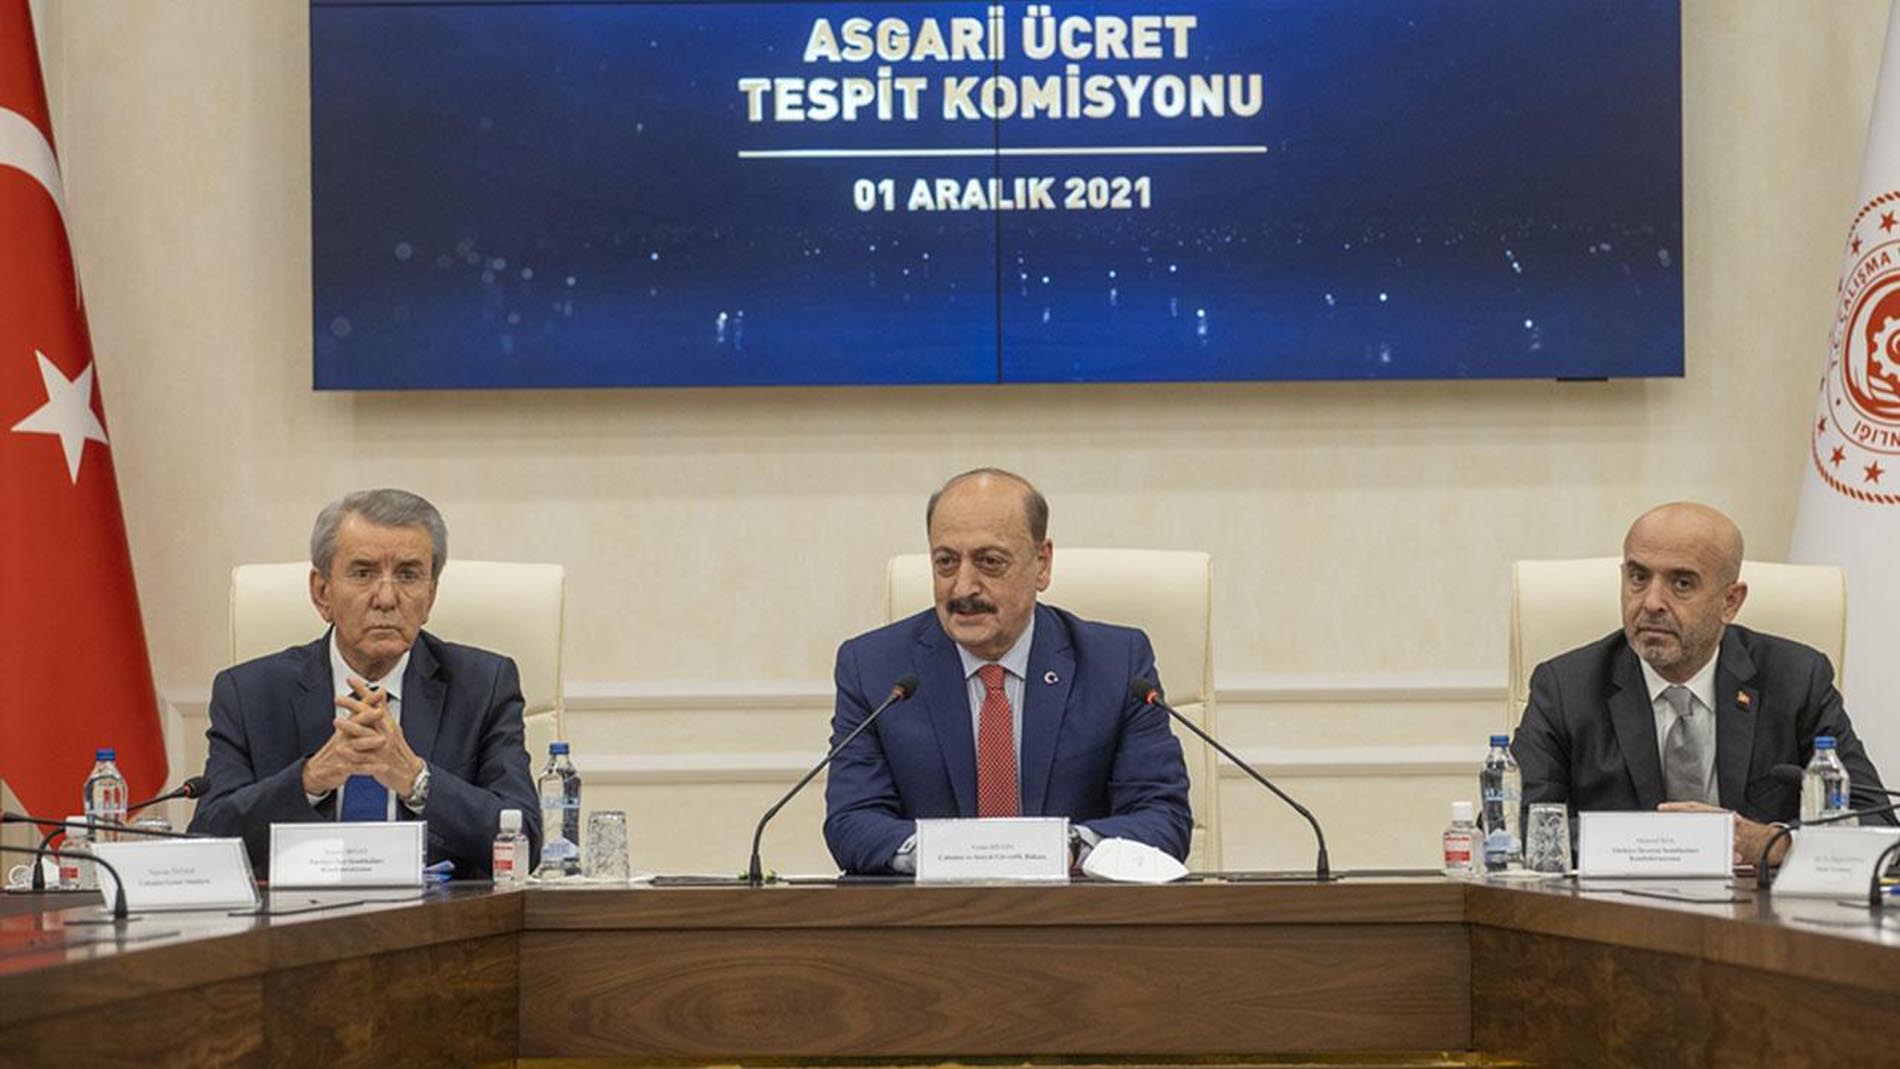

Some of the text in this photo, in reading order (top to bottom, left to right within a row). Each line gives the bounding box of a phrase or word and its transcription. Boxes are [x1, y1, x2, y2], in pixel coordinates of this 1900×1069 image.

[803, 5, 1197, 62] ASGARİ ÜCRET
[737, 64, 1264, 121] TESPİT KOMİSYONU
[853, 177, 1153, 211] 01 ARALIK 2021
